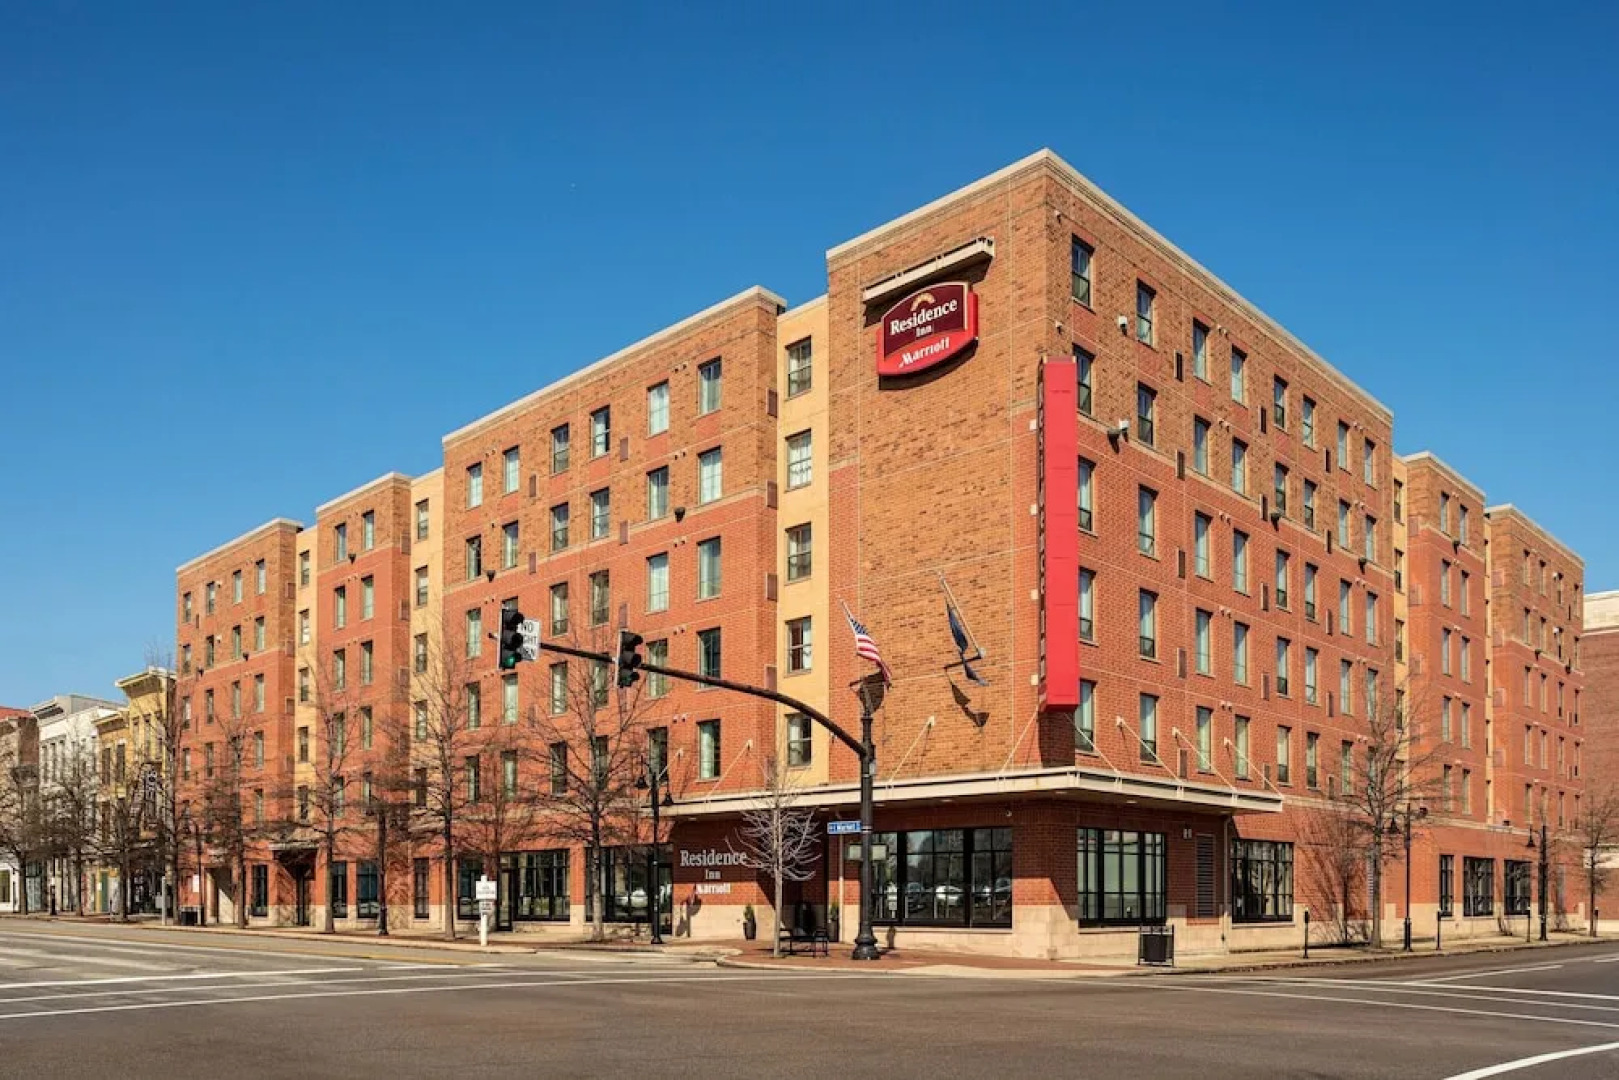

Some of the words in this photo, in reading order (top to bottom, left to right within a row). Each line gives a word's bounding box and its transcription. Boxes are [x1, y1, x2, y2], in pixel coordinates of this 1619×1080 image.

[890, 299, 958, 335] Residence
[915, 325, 932, 338] Inn
[899, 337, 950, 368] Marriott
[680, 849, 747, 867] Residence
[705, 868, 721, 880] Inn
